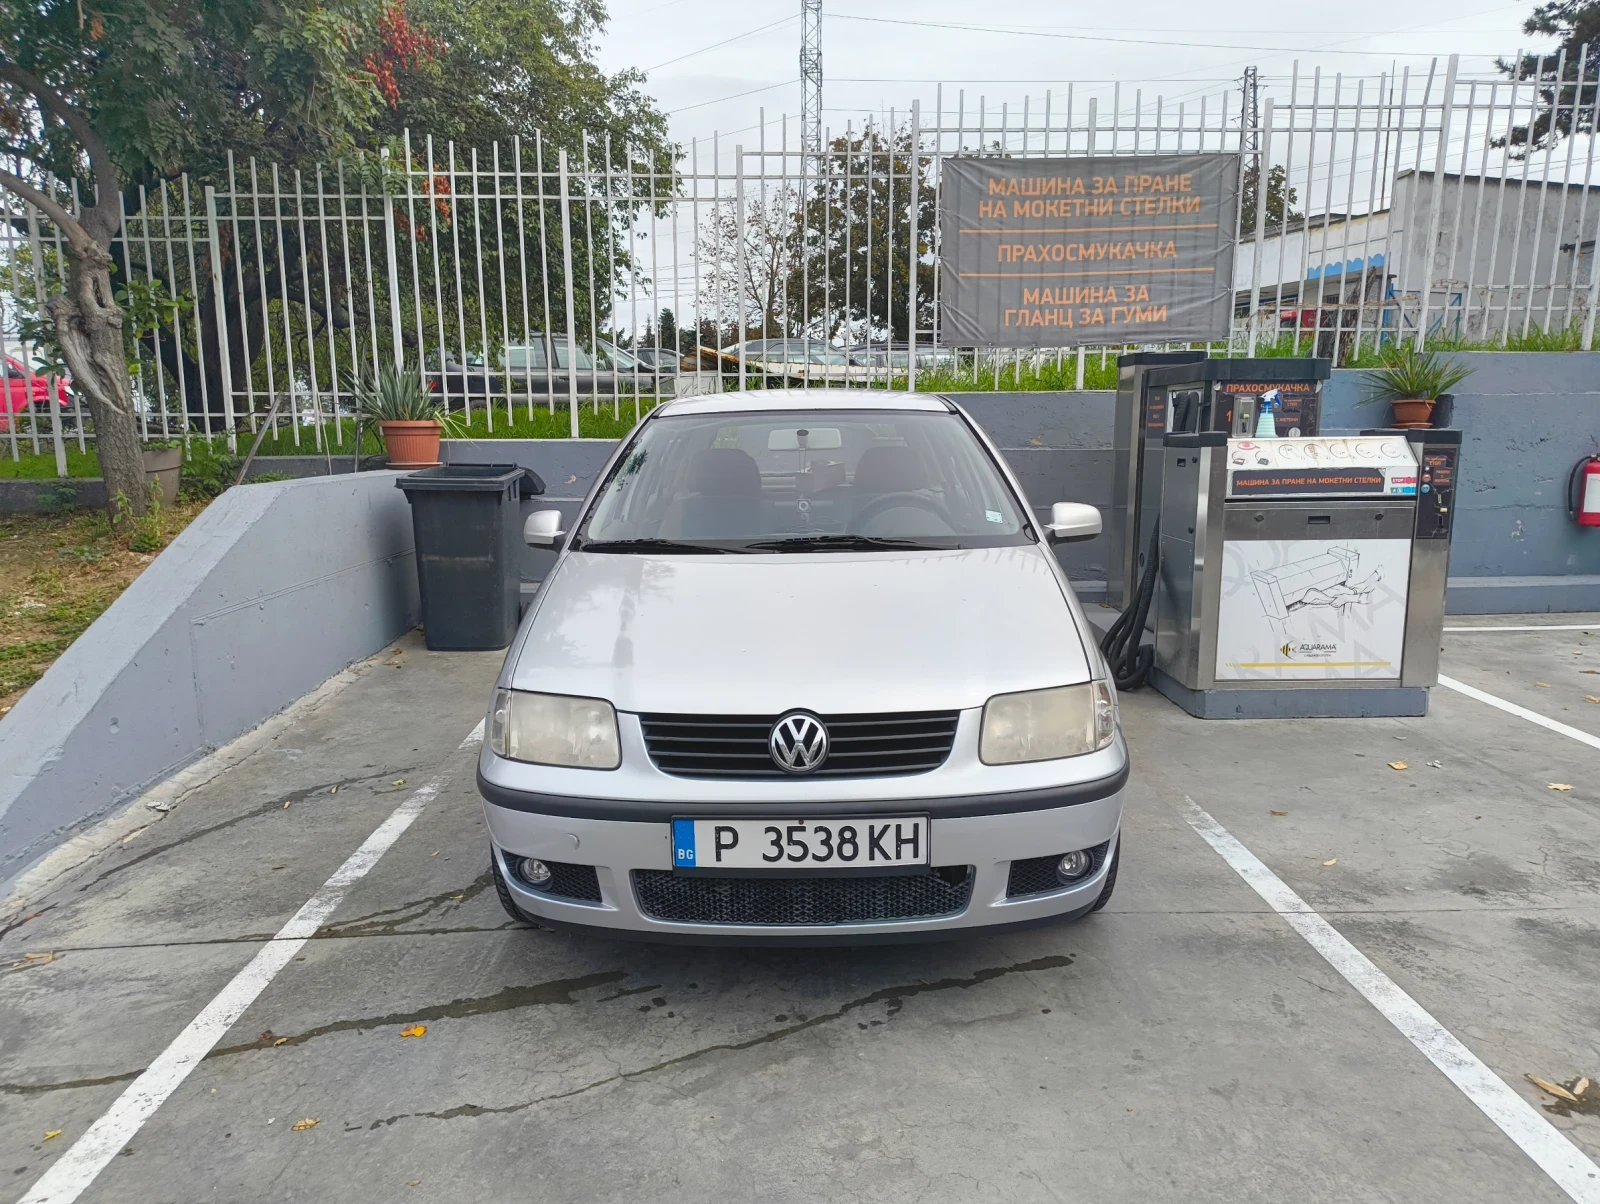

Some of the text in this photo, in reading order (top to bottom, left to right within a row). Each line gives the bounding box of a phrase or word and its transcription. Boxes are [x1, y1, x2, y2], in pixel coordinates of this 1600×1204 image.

[988, 174, 1192, 196] МАШИНА ЗА ПРАНЕ
[979, 196, 1200, 218] НА МОКЕТНИ СТЕЛКИ
[997, 240, 1177, 262] ПРАХОСМУКАЧКА
[1023, 285, 1150, 305] МАШИНА ЗА
[1005, 305, 1167, 328] ГЛАНЦ ЗА ГУМИ
[1318, 477, 1352, 485] МОКЕТНИ
[1354, 476, 1382, 484] СТЕЛКИ
[677, 848, 694, 860] BG
[714, 826, 739, 862] P
[762, 826, 859, 862] 3538
